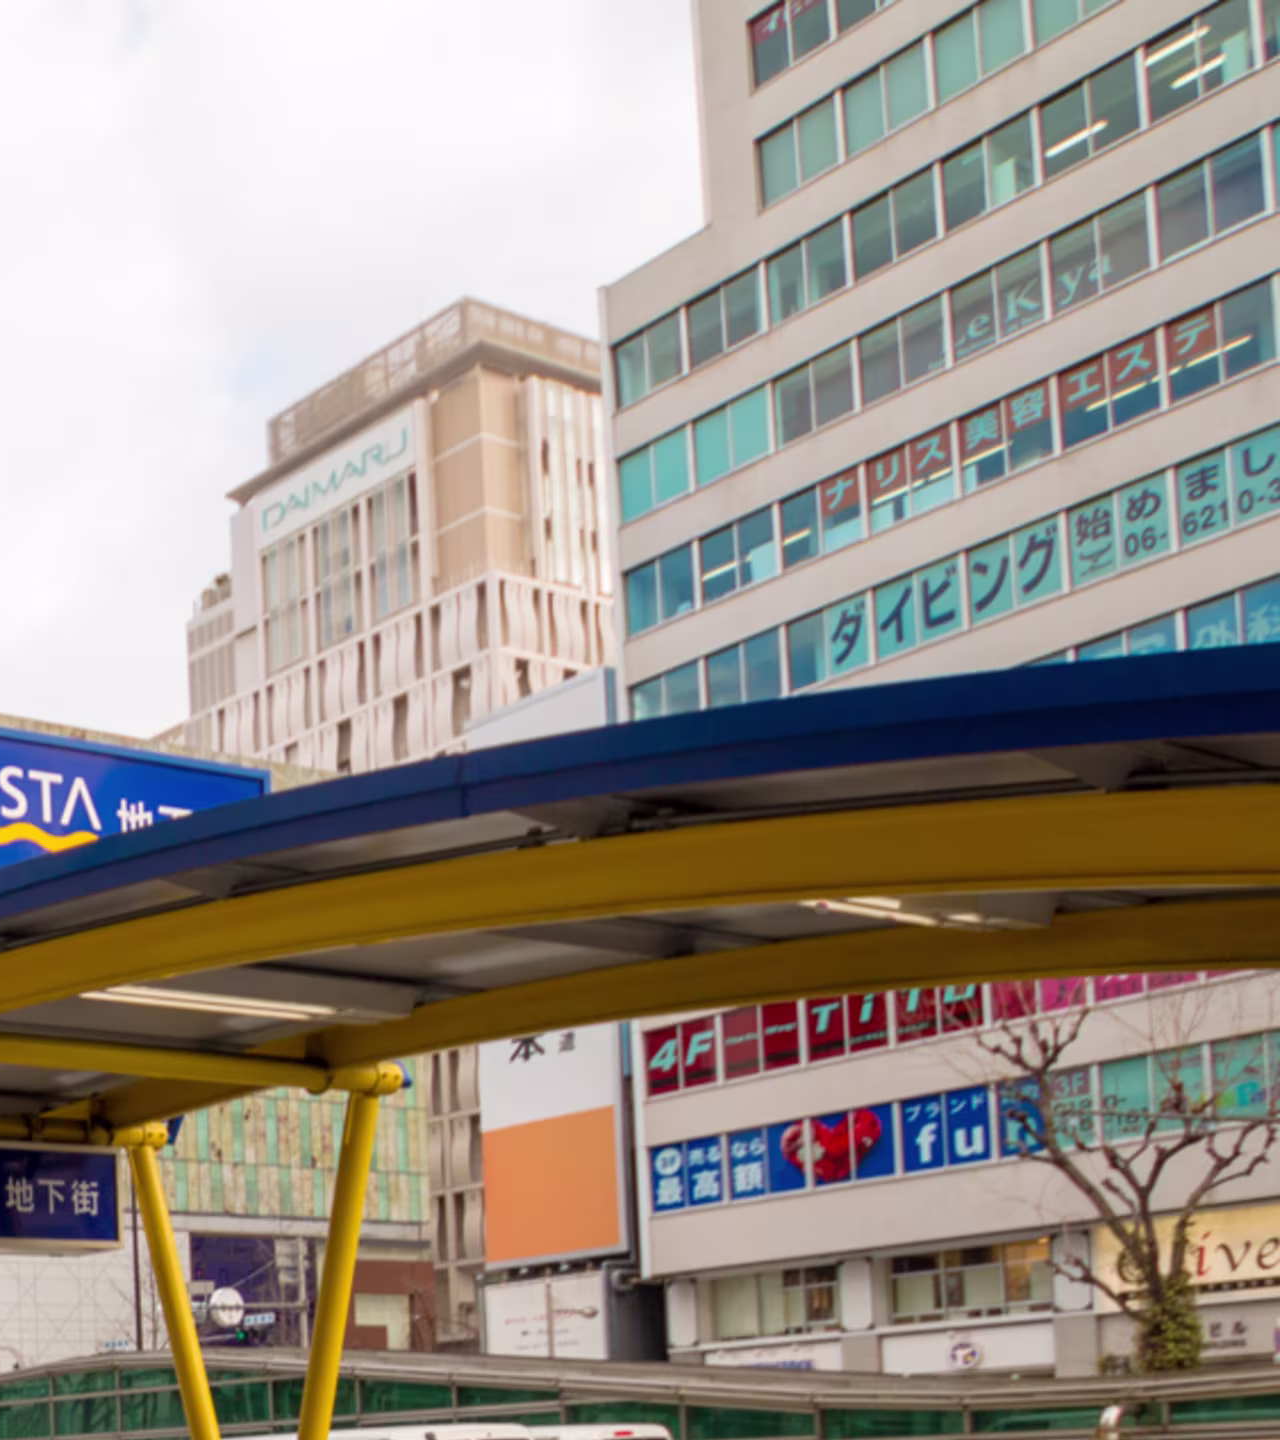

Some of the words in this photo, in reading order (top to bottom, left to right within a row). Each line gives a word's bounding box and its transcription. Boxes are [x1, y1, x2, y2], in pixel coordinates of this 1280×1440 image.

[260, 428, 408, 533] DAIMARU
[648, 1029, 715, 1073] 4F
[4, 1178, 100, 1217] 地下街
